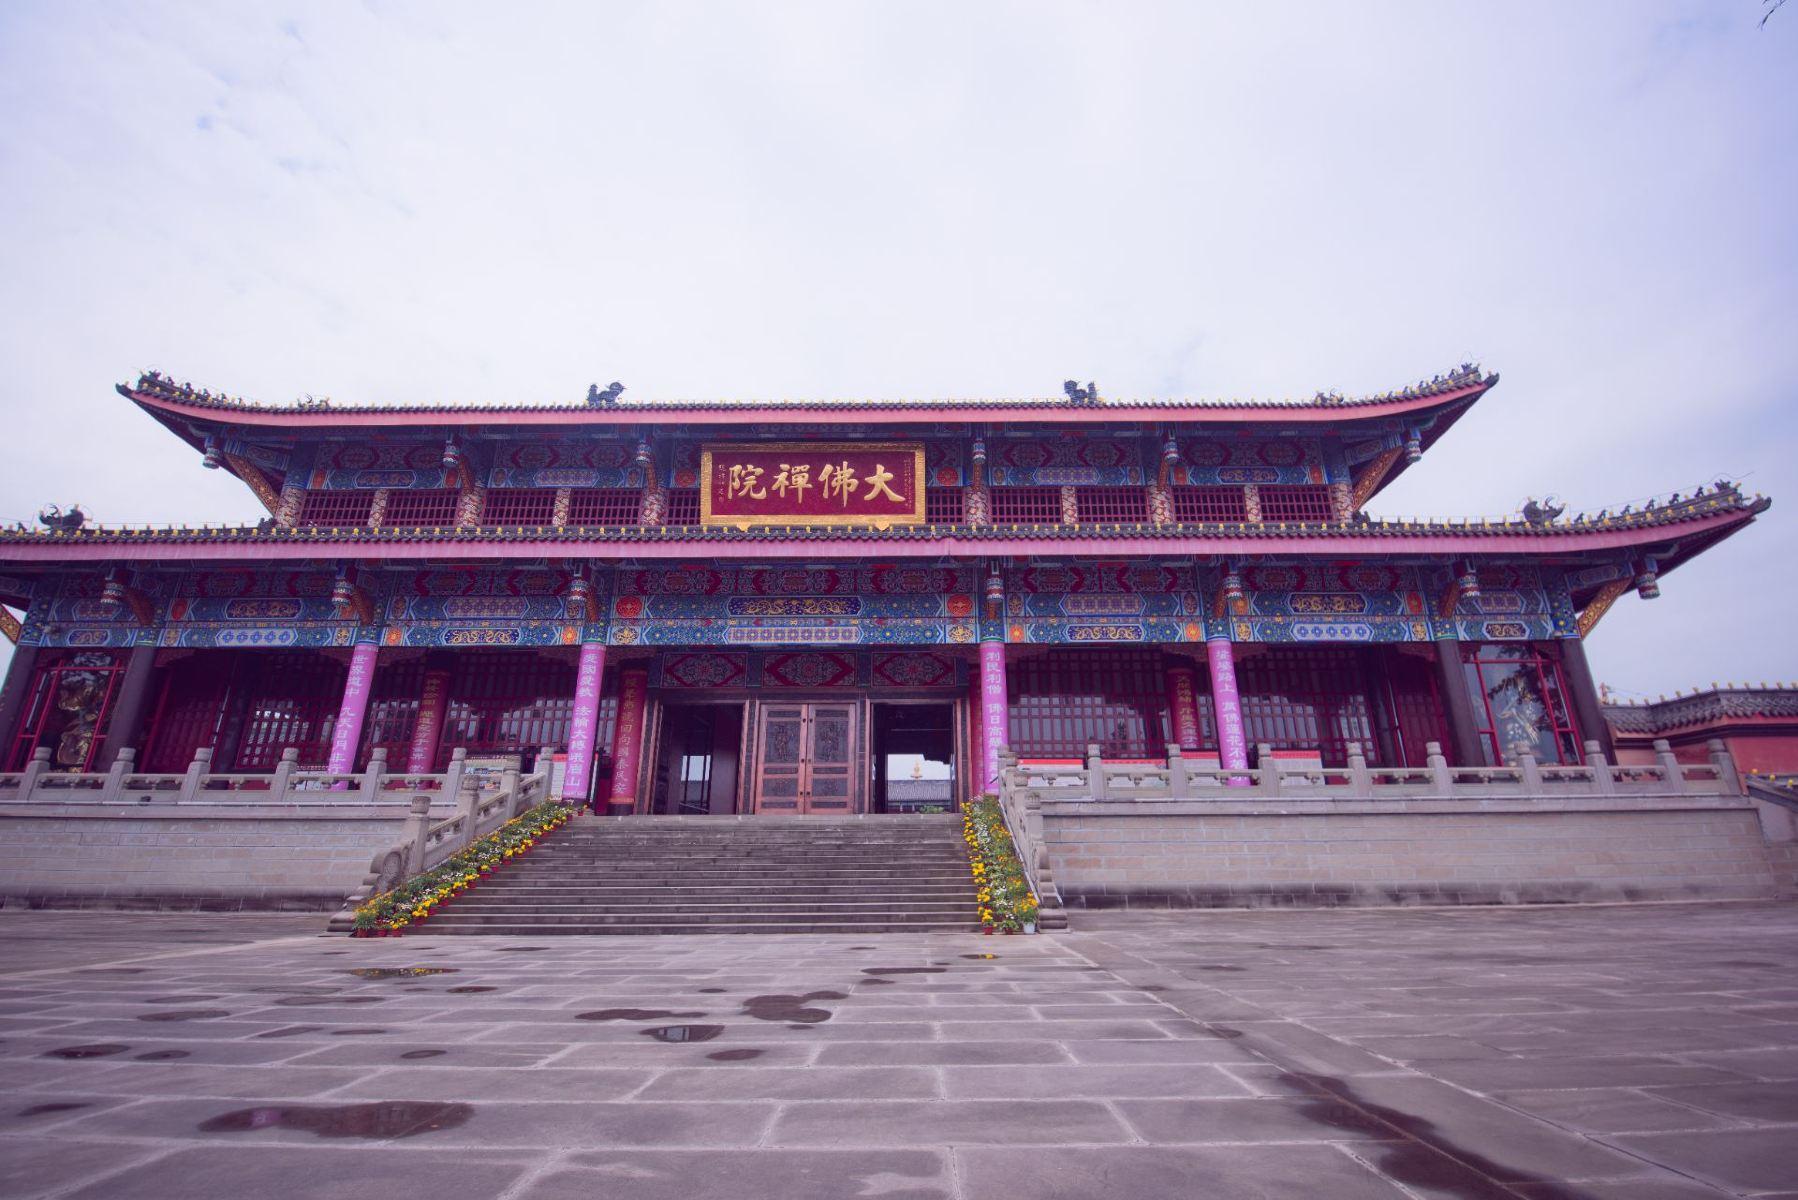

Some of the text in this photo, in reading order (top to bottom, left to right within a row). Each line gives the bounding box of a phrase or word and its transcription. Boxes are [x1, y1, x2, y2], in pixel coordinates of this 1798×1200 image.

[728, 461, 906, 507] 大佛禪院
[986, 652, 1002, 695] 利民利僧
